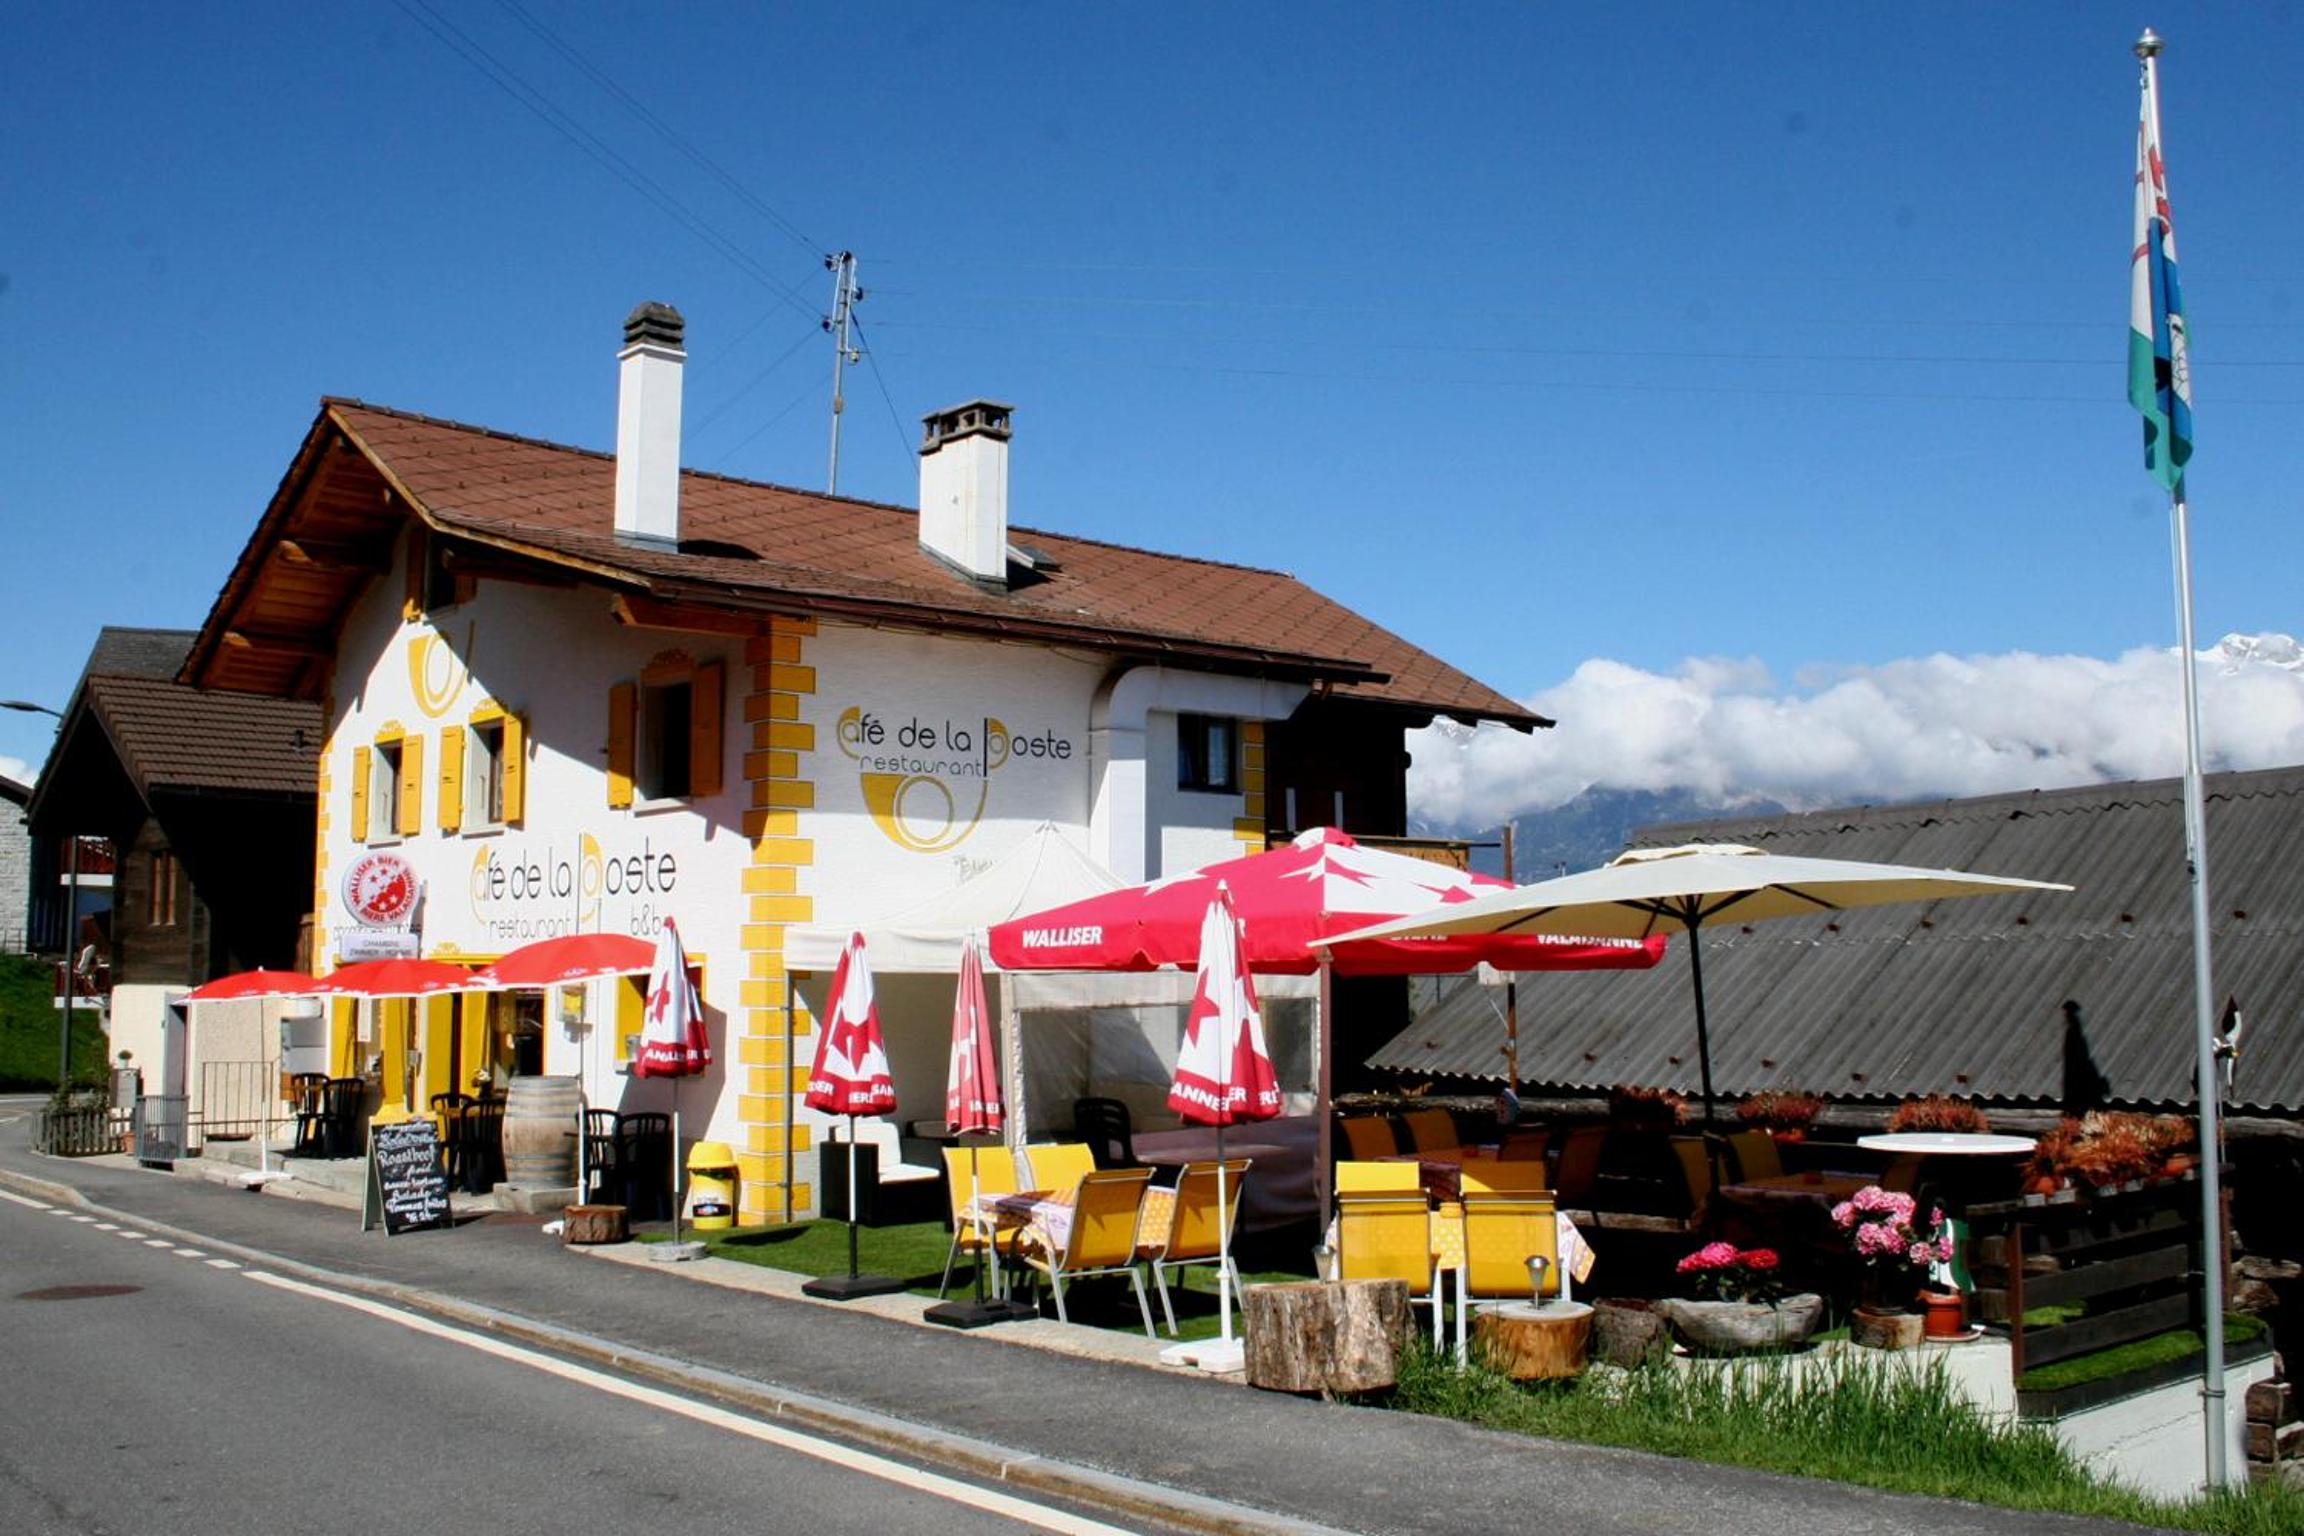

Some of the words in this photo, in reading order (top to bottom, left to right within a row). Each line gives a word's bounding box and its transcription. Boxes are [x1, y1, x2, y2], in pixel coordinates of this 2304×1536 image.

[860, 753, 981, 777] restaurant
[898, 717, 937, 749] de
[946, 720, 972, 751] la
[983, 717, 1072, 777] poste
[511, 848, 541, 899] de
[549, 846, 572, 897] la
[576, 832, 676, 934] poste
[489, 911, 572, 939] restaurant
[630, 903, 662, 935] b&b
[1022, 925, 1103, 948] WALLISER
